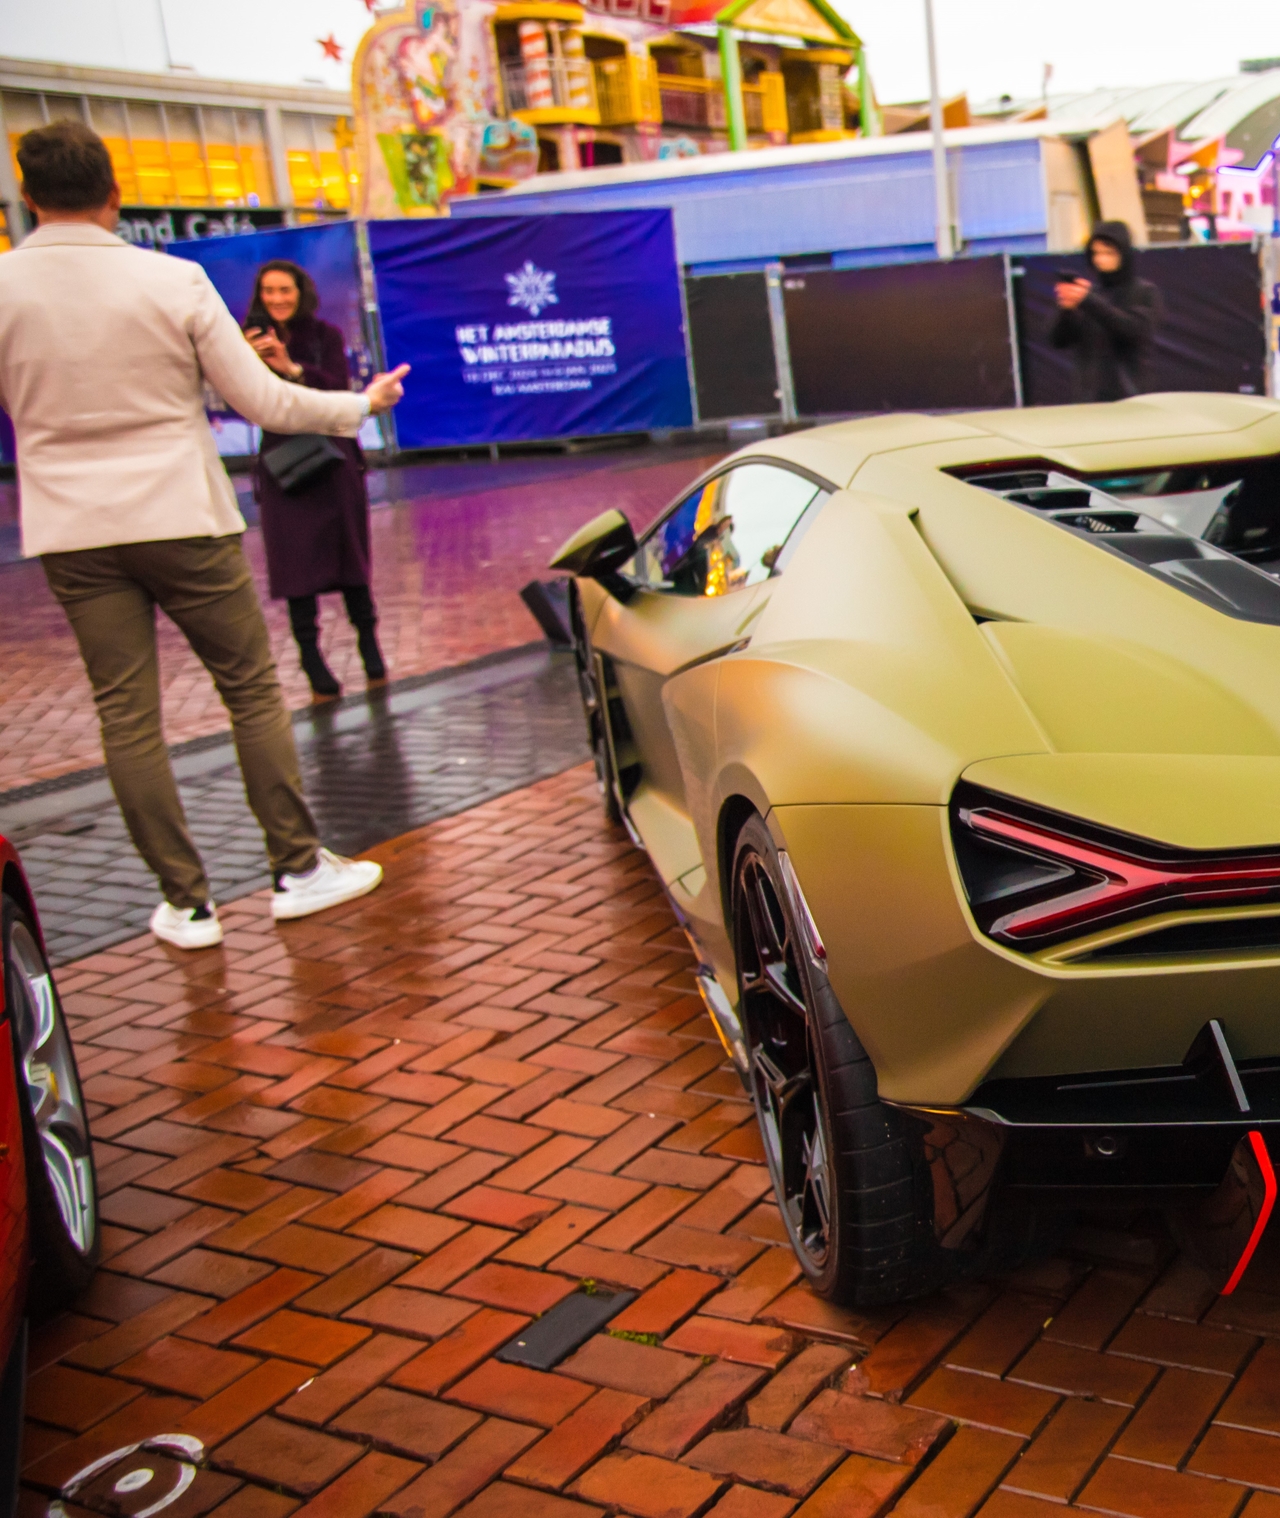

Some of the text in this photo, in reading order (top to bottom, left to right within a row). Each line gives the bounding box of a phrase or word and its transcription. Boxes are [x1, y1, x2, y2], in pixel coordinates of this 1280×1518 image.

[116, 212, 176, 244] and
[492, 316, 611, 342] AMSTERDAMSE
[459, 336, 616, 364] WINTERPARADIJS
